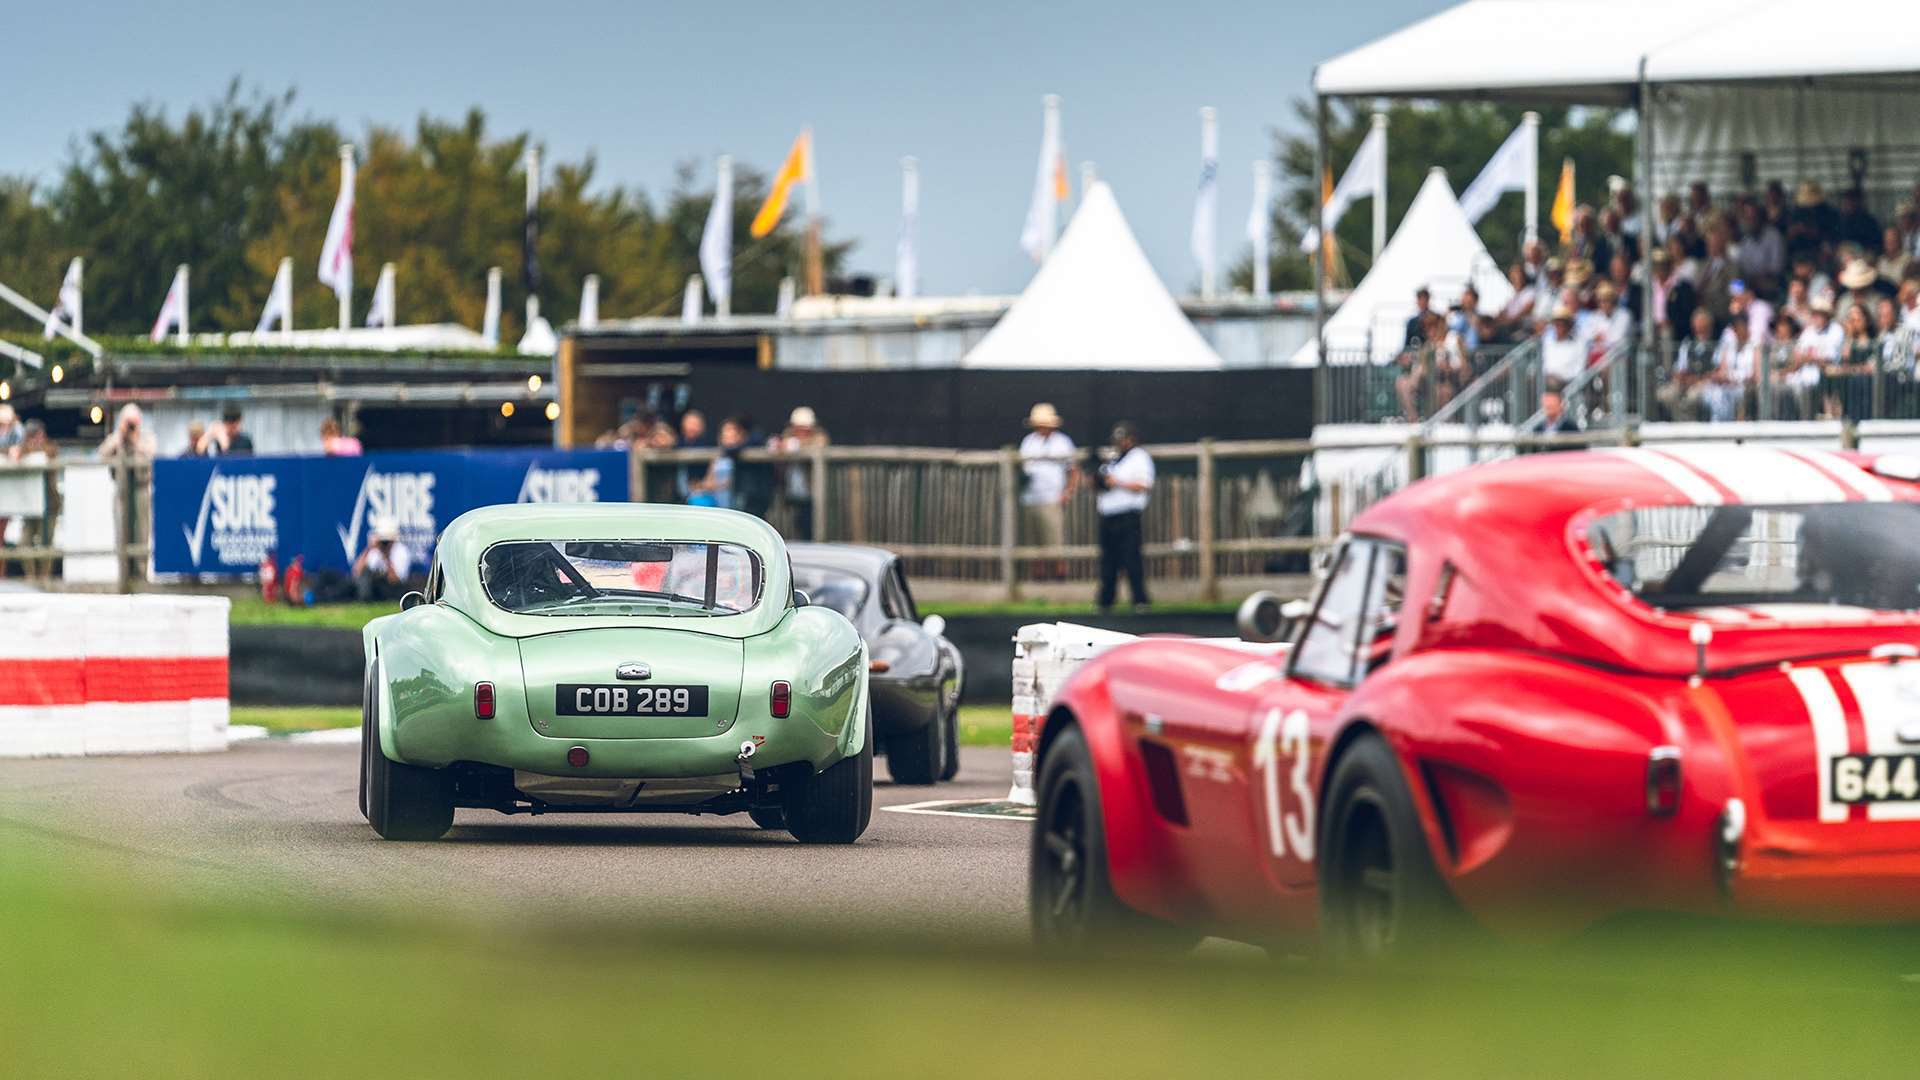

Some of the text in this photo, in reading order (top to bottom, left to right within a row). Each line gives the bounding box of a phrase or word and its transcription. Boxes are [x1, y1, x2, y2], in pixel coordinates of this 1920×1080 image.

[212, 474, 277, 529] SURE
[366, 472, 435, 529] SURE
[576, 688, 689, 713] COB 289
[1254, 707, 1315, 862] 13
[1835, 757, 1919, 800] 644
